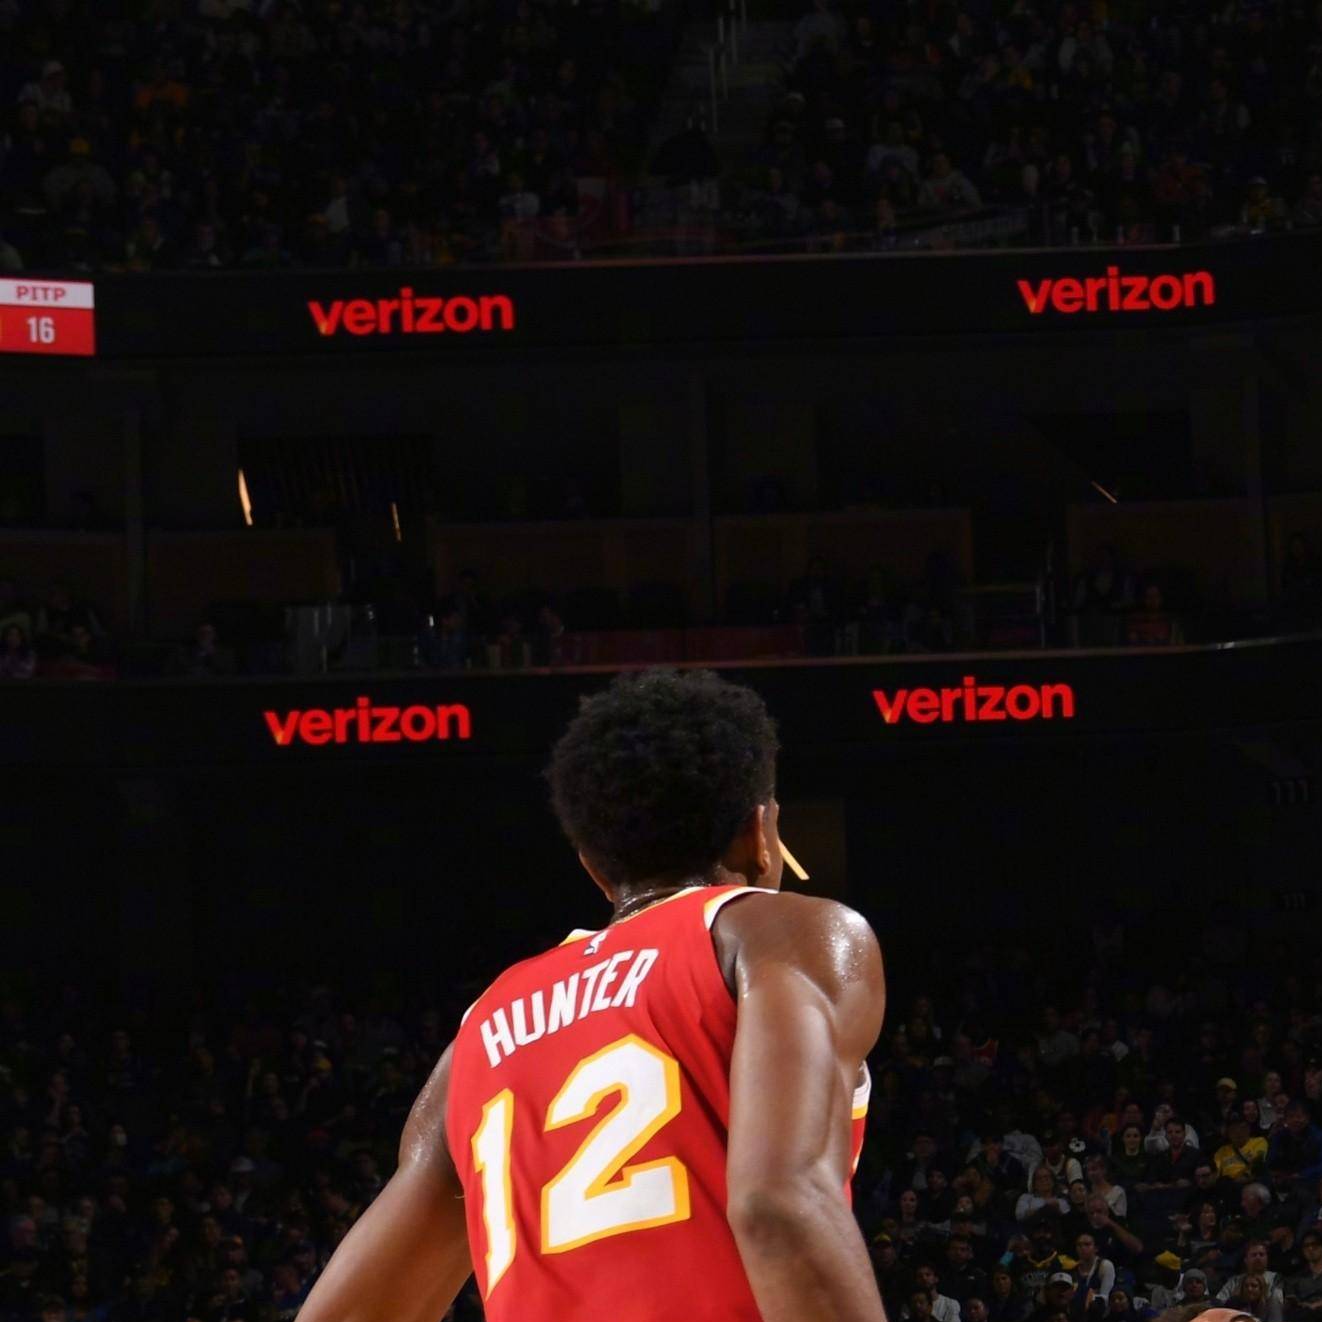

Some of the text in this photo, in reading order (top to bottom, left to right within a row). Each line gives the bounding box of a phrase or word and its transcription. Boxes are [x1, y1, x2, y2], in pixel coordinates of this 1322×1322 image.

[16, 286, 66, 301] PITP
[308, 286, 514, 336] verizon
[1018, 265, 1215, 314] verizon
[27, 316, 55, 344] 16
[264, 696, 471, 746] verizon
[872, 675, 1075, 725] verizon
[479, 948, 660, 1069] HUNTER
[470, 1032, 692, 1303] 12
